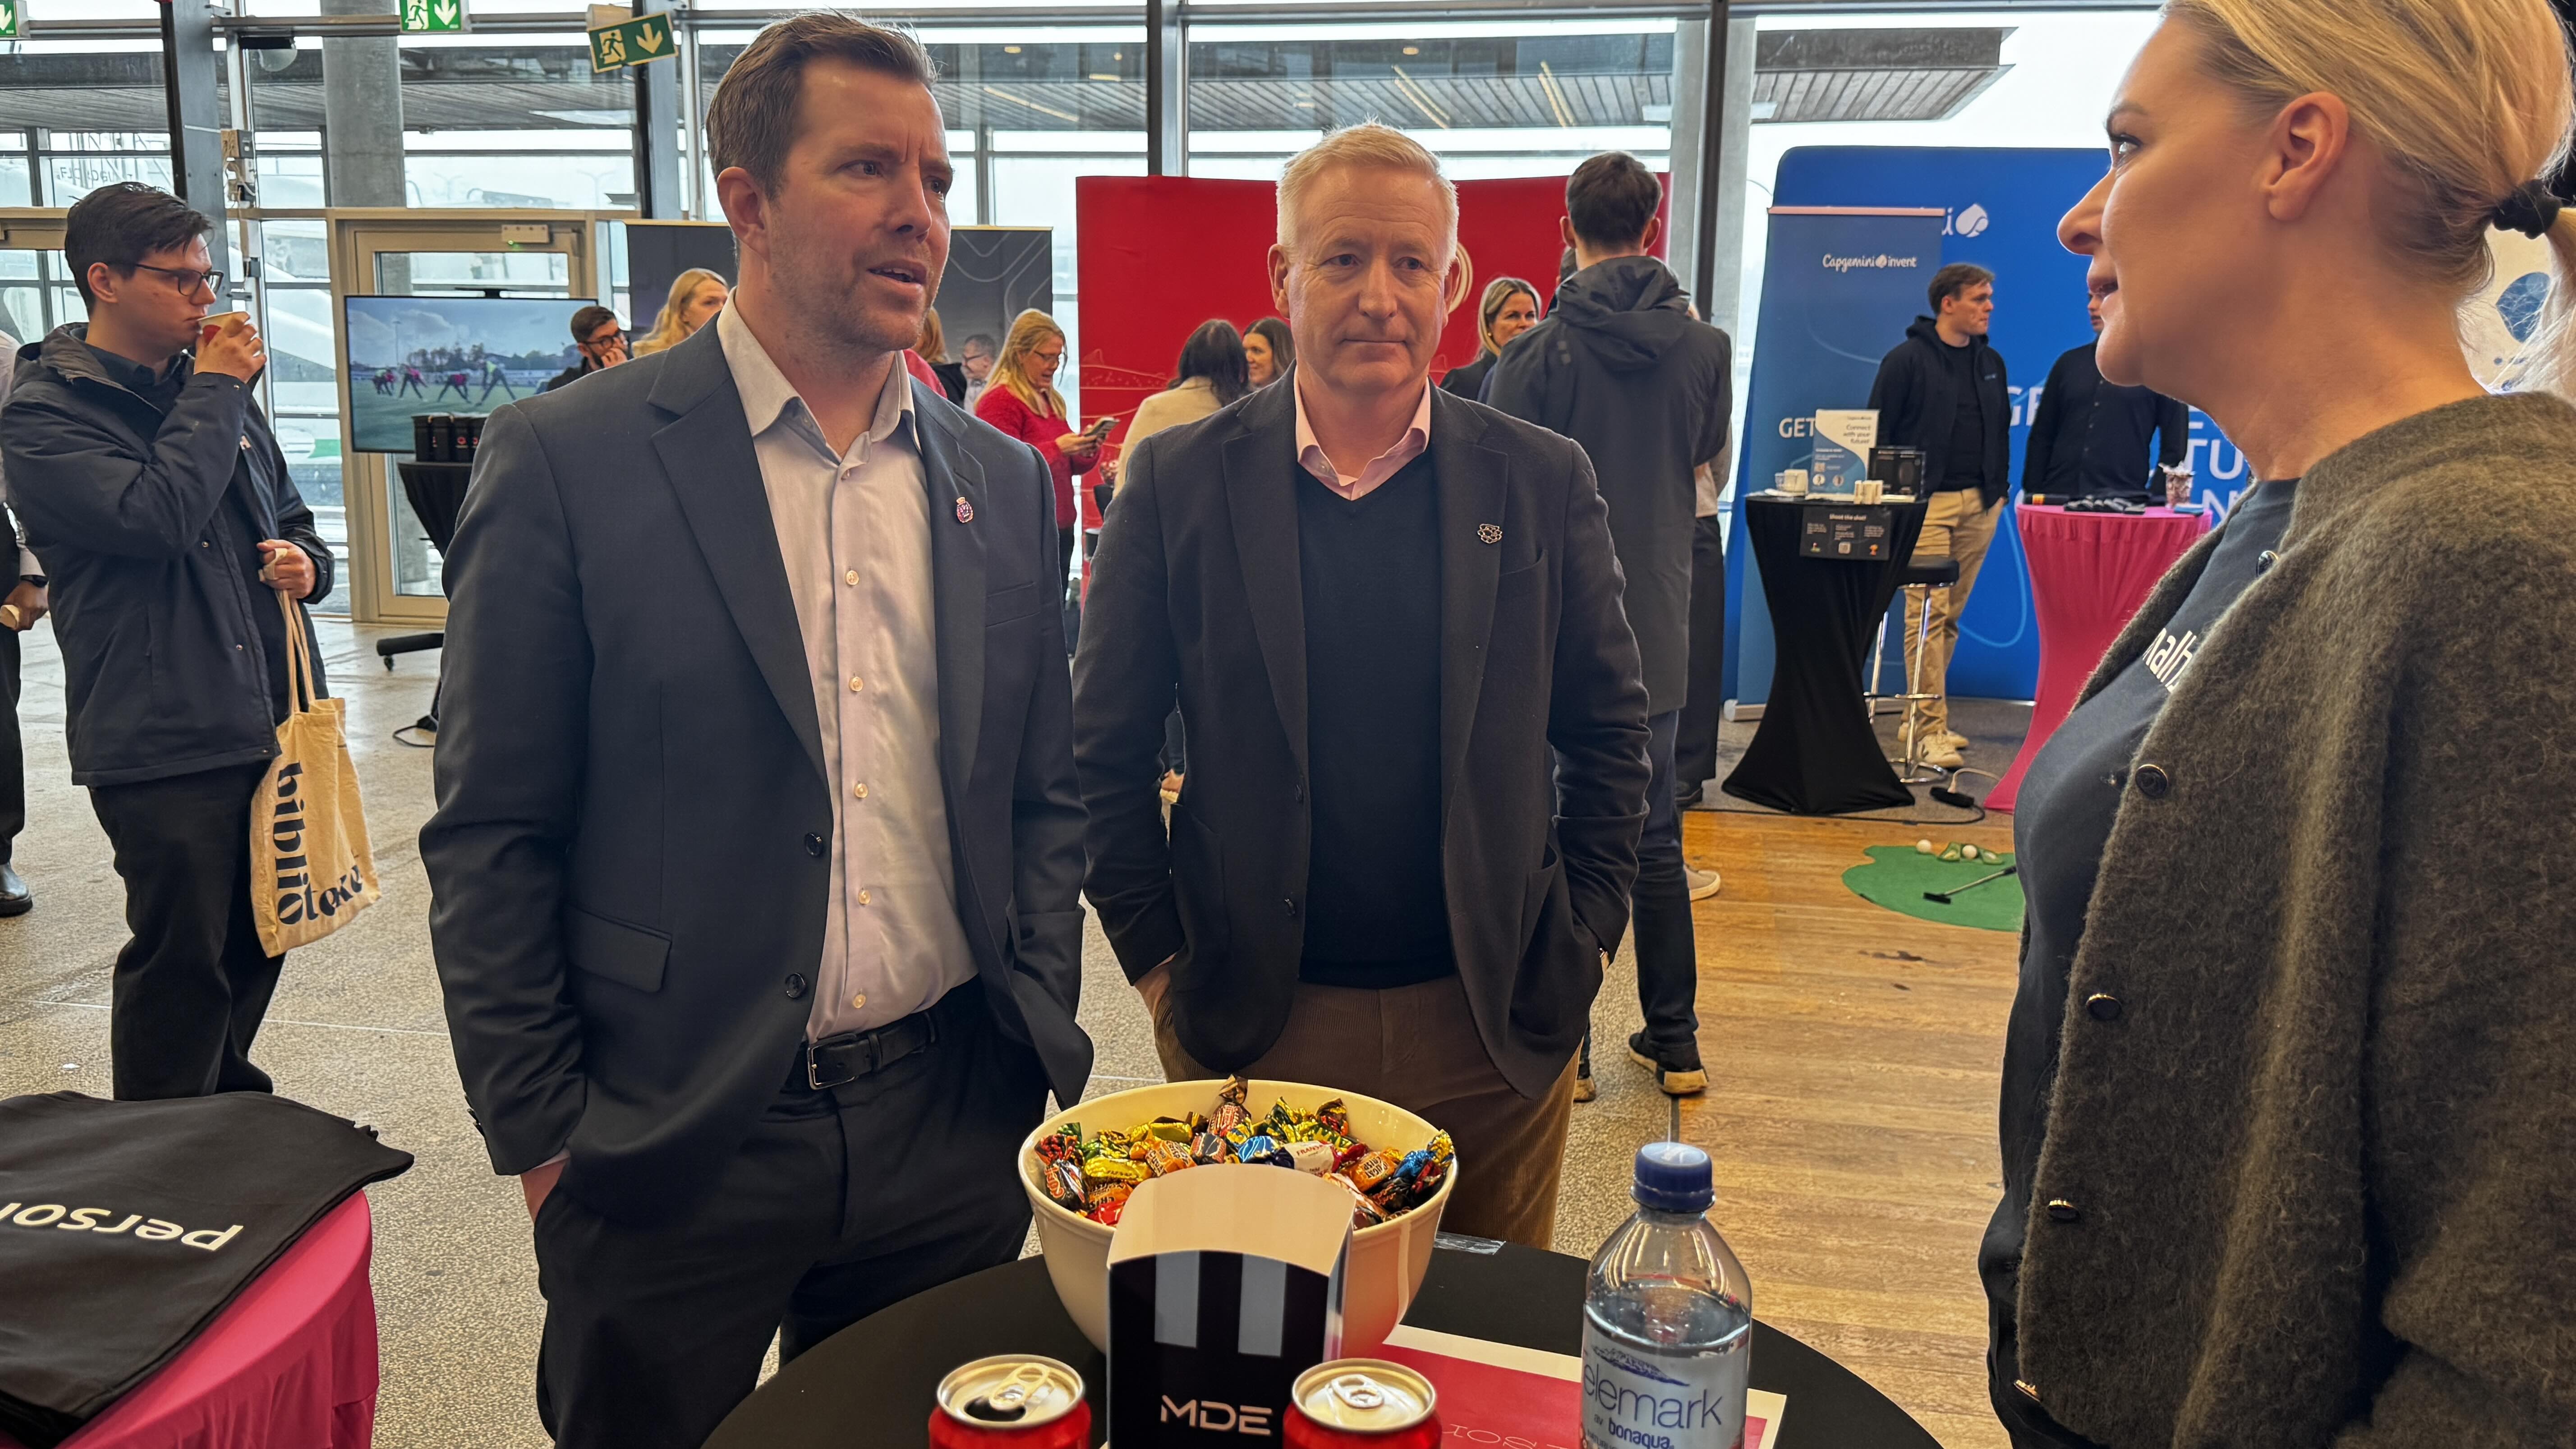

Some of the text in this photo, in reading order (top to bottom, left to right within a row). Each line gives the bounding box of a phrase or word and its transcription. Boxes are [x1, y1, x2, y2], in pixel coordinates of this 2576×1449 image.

[1822, 254, 1917, 272] Capgemini invent
[1779, 417, 1815, 438] GET
[1583, 1364, 1722, 1429] elemark
[1160, 1395, 1272, 1435] MDE
[1609, 1417, 1670, 1449] bonaqua
